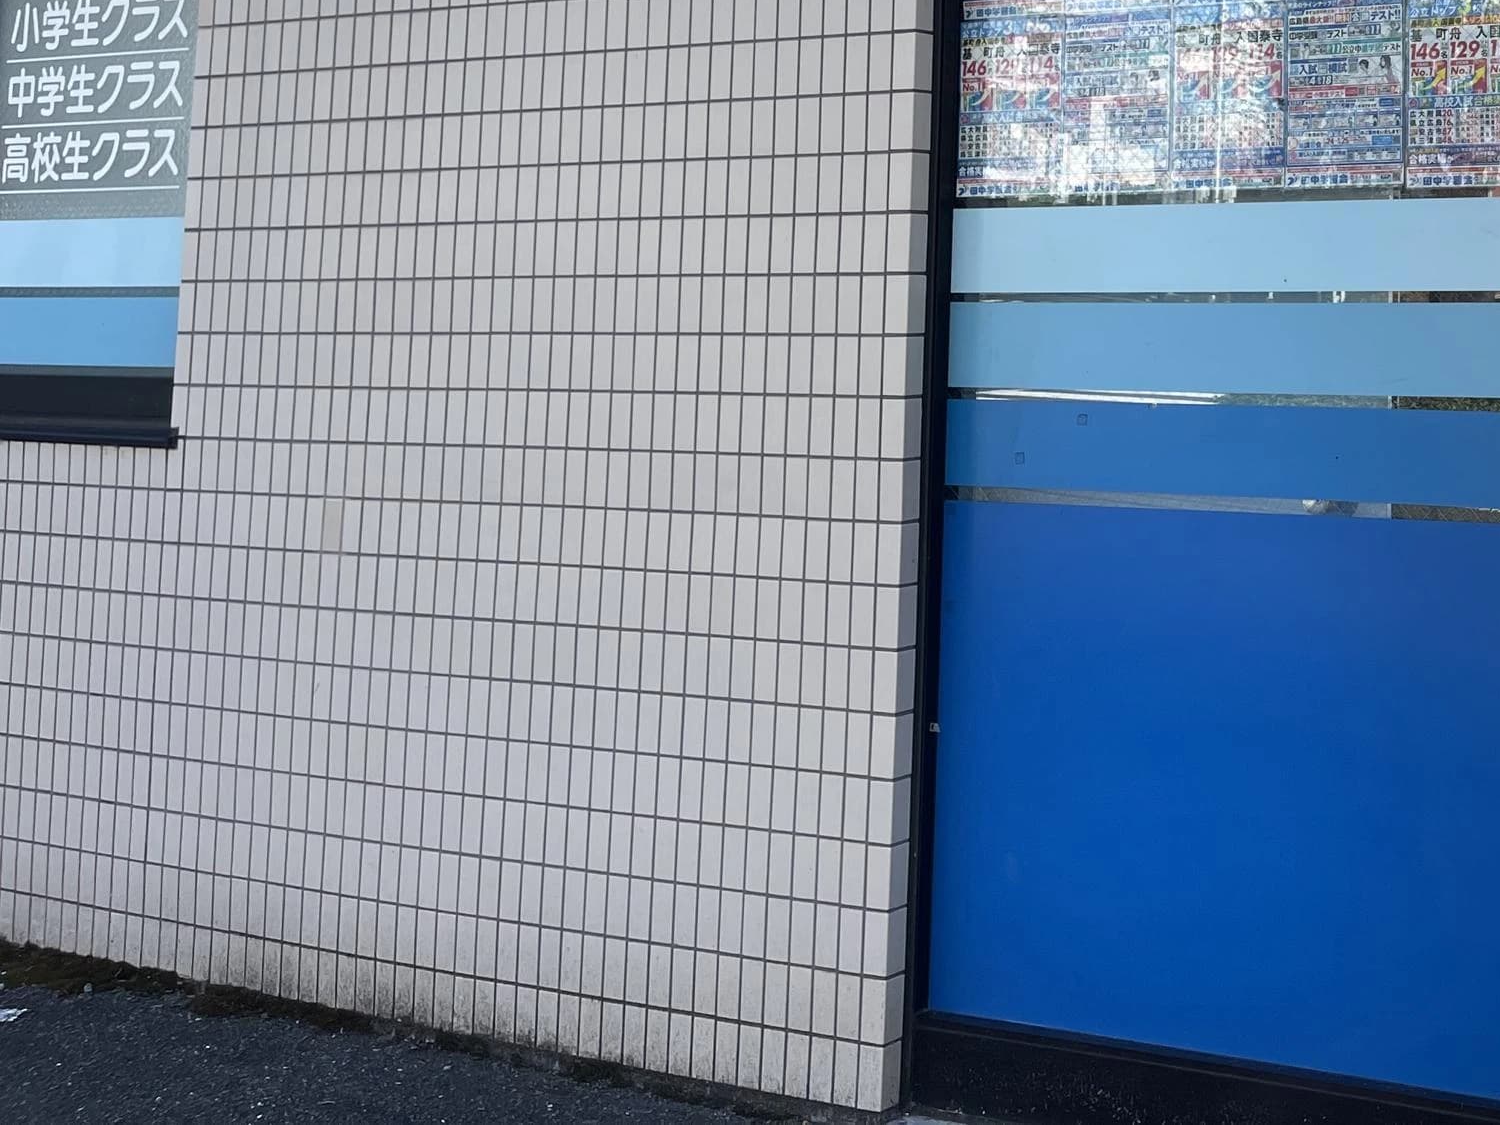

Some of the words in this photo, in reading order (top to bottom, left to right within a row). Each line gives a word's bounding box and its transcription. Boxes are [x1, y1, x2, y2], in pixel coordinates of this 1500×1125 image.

[1411, 42, 1440, 60] 146
[1450, 40, 1480, 58] 129
[963, 59, 987, 76] 146
[1411, 67, 1434, 77] No.1
[1450, 66, 1473, 76] No.1
[8, 61, 183, 118] 中学生クラス
[2, 129, 179, 184] 高校生クラス
